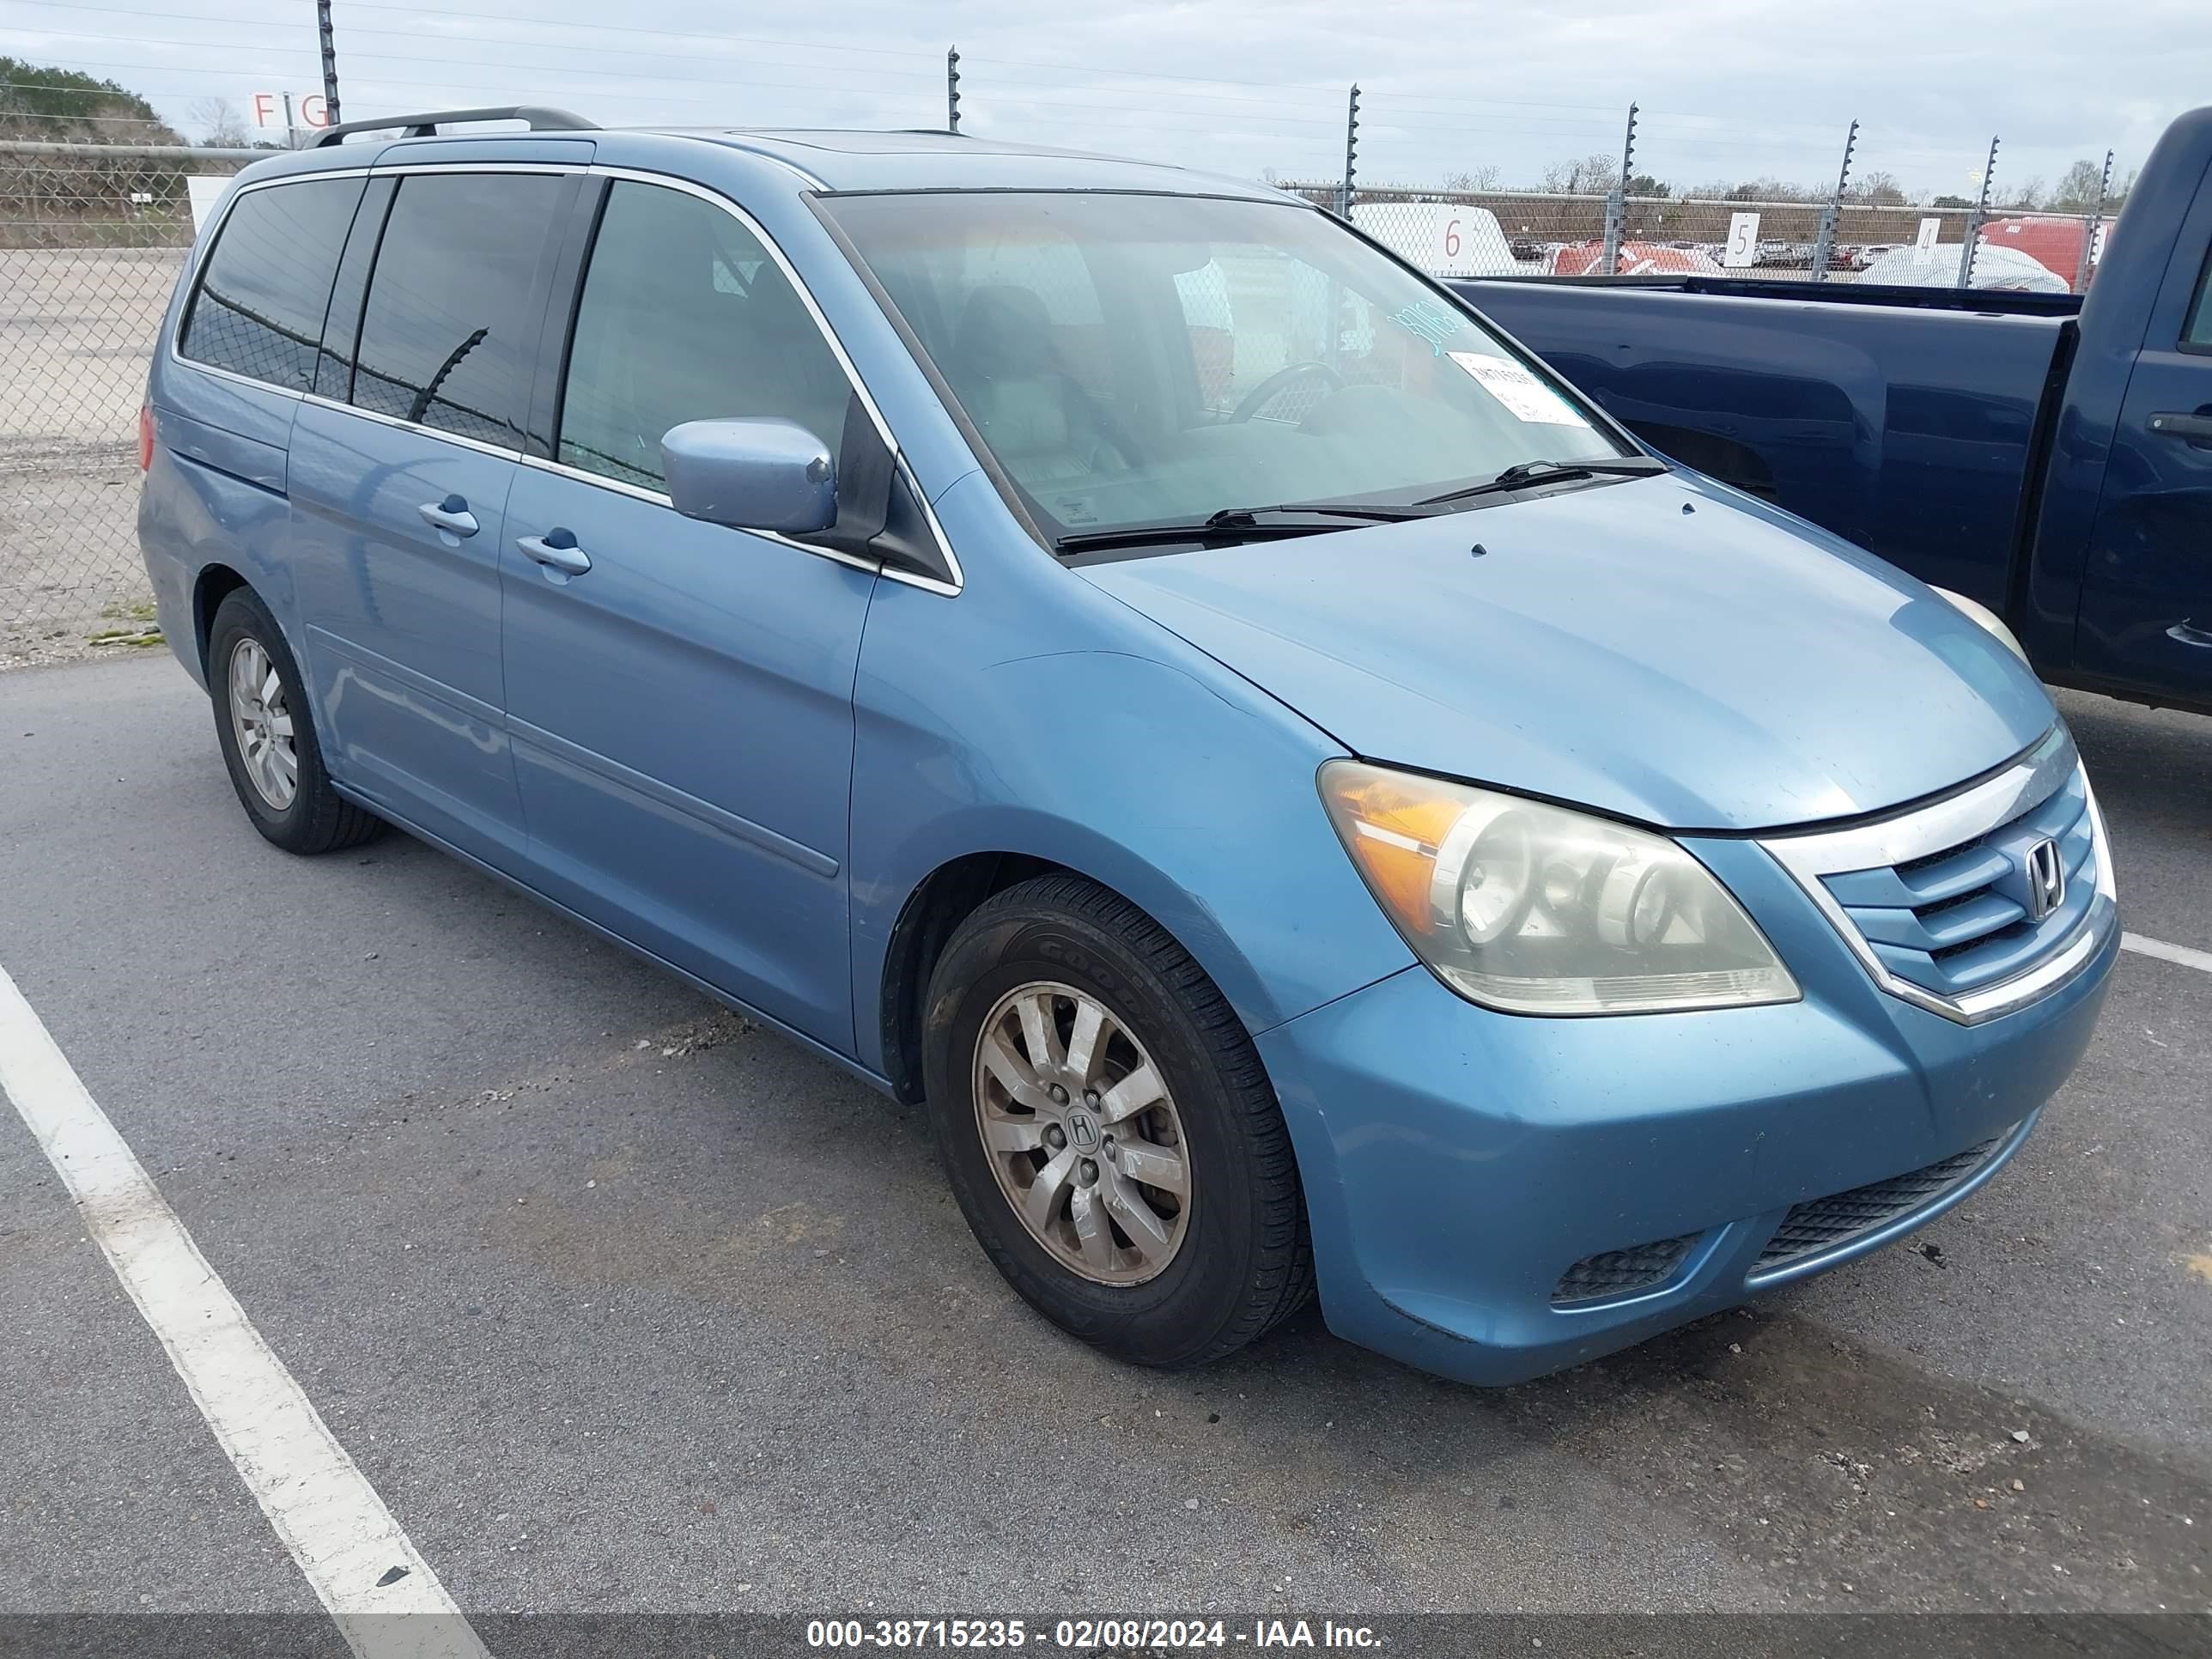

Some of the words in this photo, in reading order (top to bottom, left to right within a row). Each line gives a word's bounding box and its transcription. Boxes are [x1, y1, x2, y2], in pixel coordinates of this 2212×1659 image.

[255, 94, 274, 128] F
[301, 94, 330, 128] G
[1445, 219, 1461, 258] 6
[1735, 224, 1749, 255] 5
[1921, 228, 1932, 255] 4
